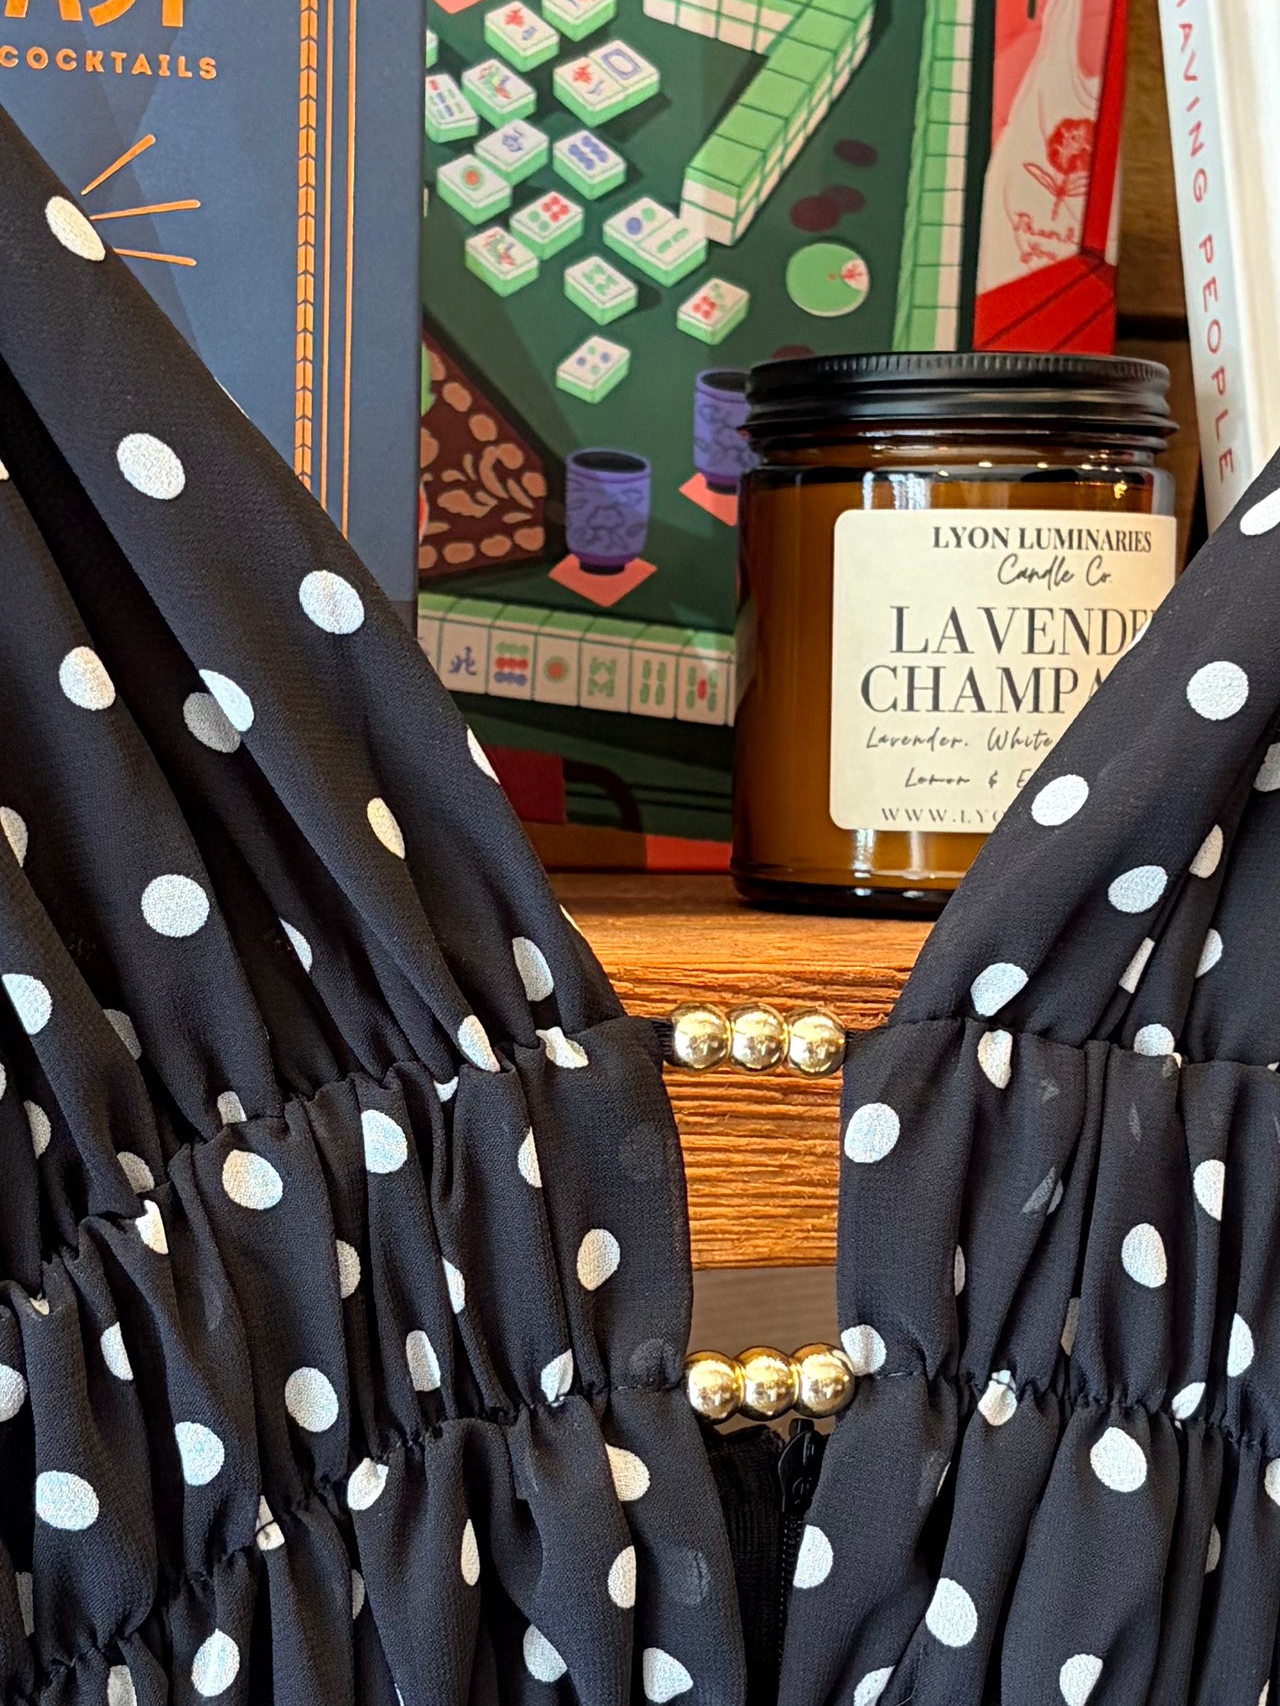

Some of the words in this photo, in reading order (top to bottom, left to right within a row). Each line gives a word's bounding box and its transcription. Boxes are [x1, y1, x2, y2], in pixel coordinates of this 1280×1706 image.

[1199, 234, 1235, 483] PEOPLE
[932, 526, 1010, 549] LYON
[1017, 526, 1153, 553] LUMINARIES
[998, 554, 1075, 591] Candle
[888, 605, 1156, 656] LAVENDE
[986, 726, 1054, 751] White
